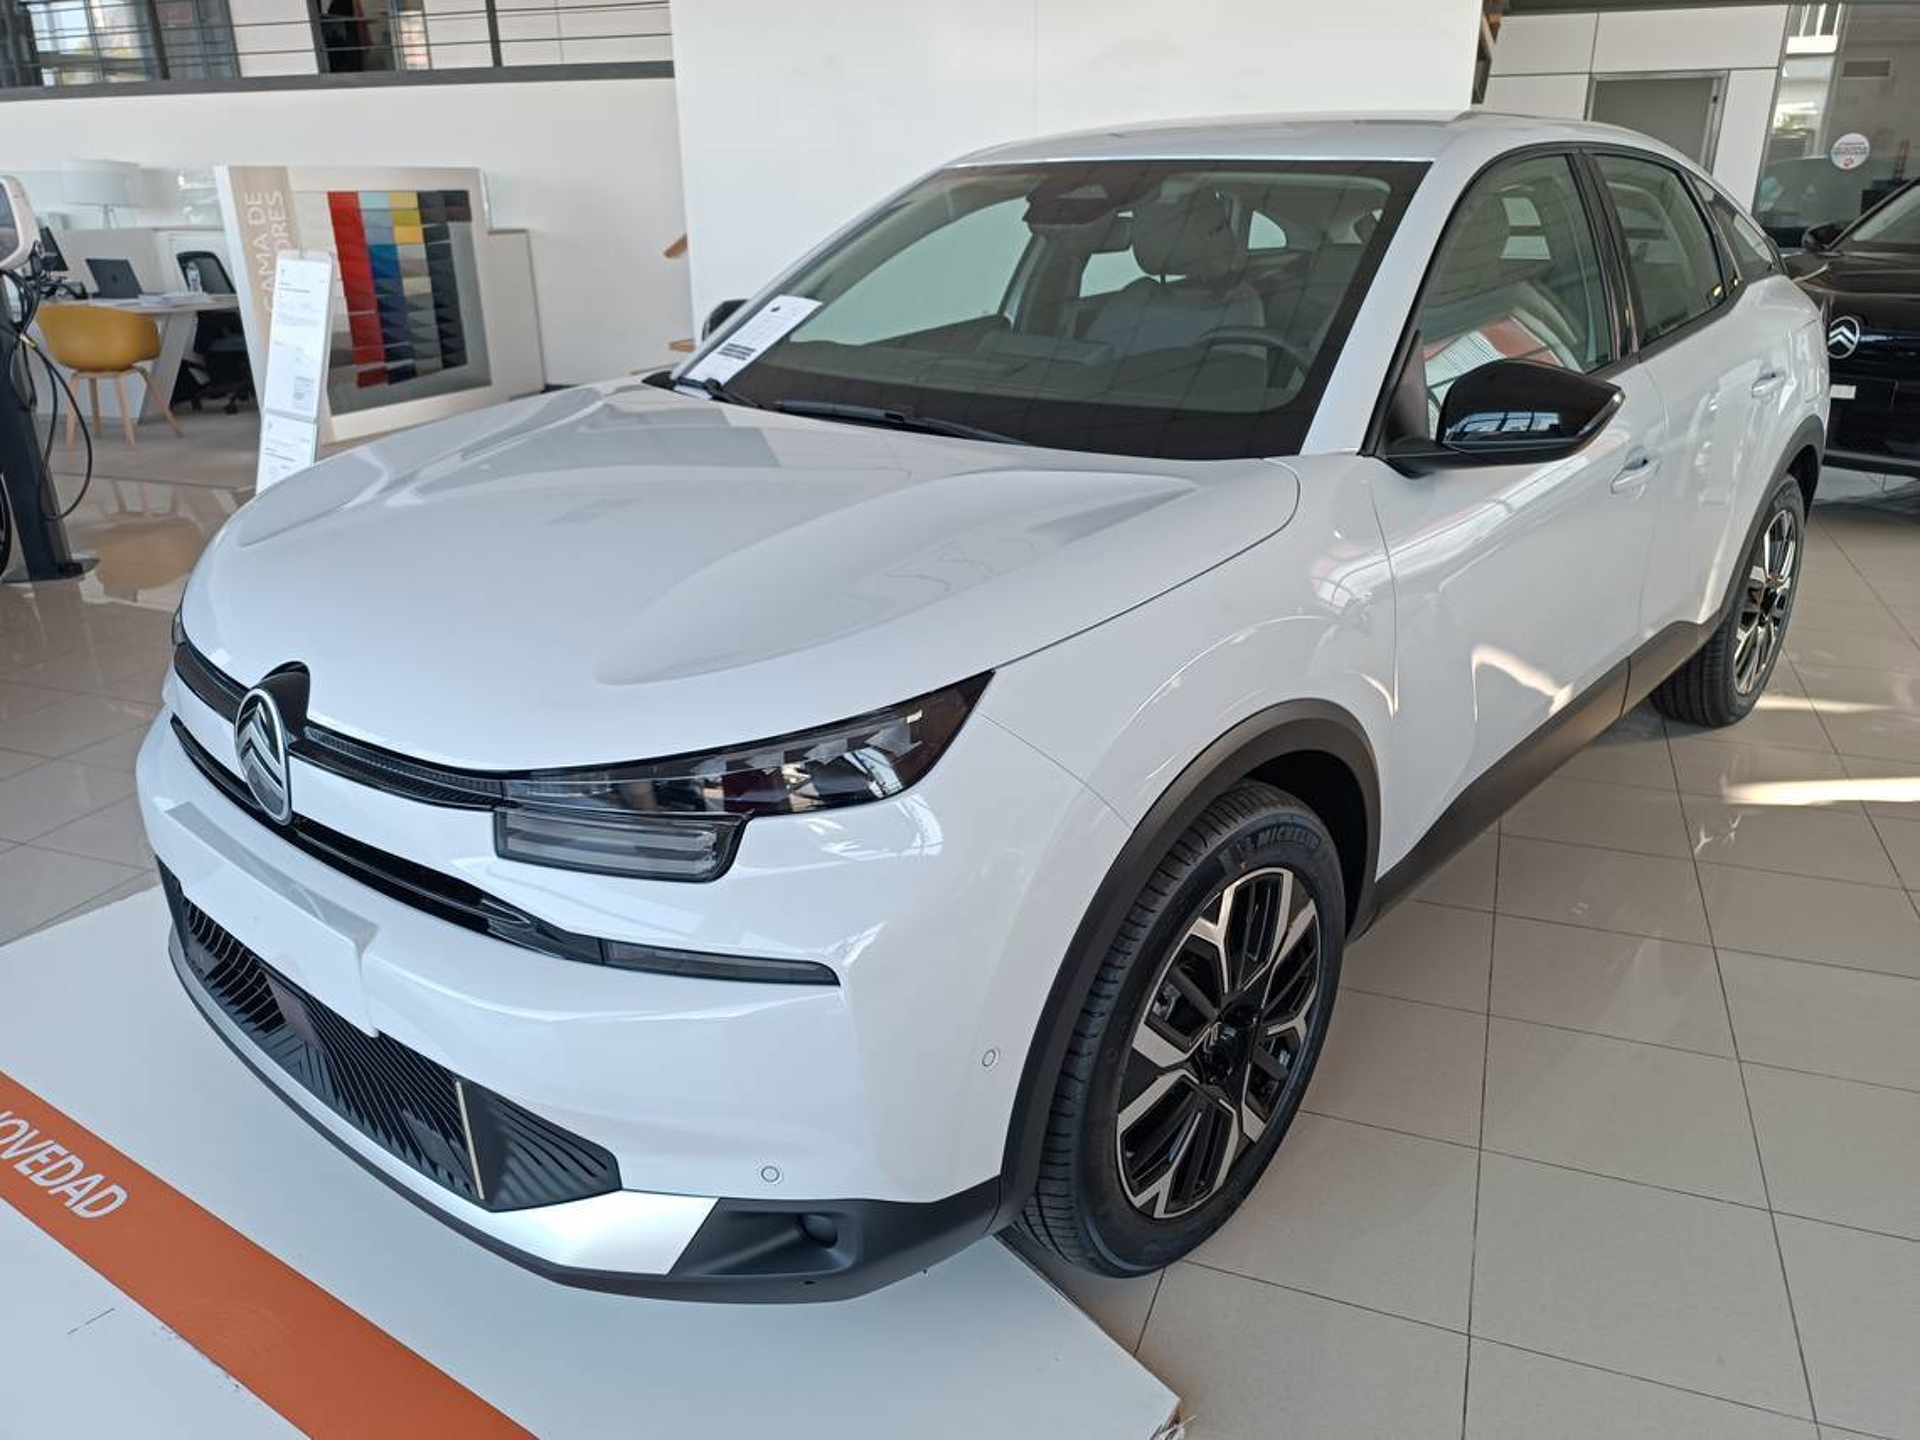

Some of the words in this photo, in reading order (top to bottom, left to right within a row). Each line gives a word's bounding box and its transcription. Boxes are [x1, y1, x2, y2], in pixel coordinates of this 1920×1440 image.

[243, 191, 266, 225] DE
[267, 190, 291, 252] ORES
[0, 1111, 128, 1219] OVEDAD
